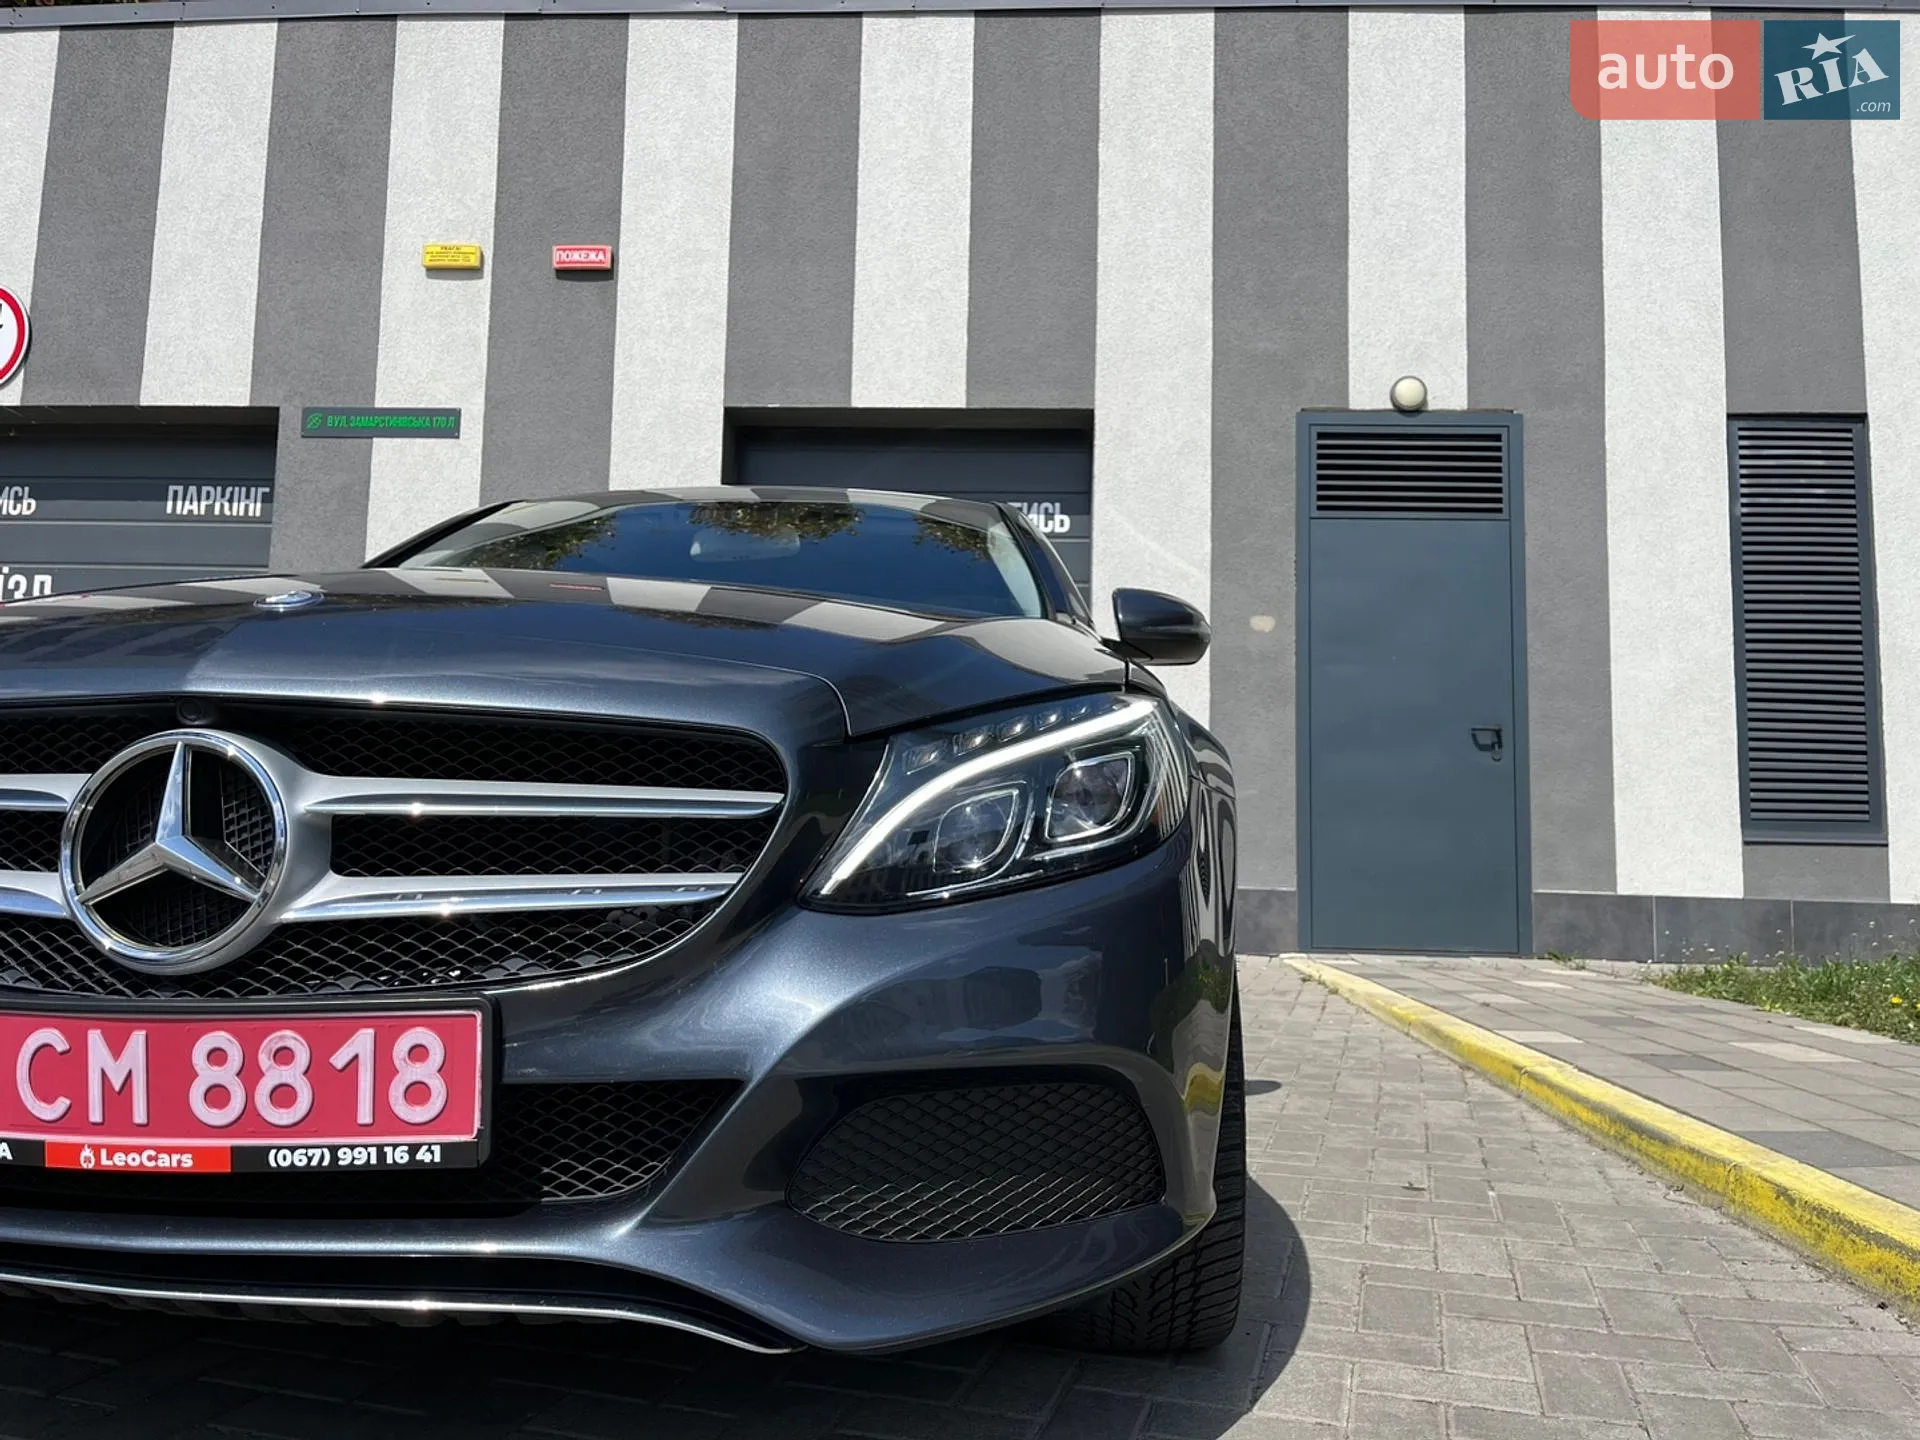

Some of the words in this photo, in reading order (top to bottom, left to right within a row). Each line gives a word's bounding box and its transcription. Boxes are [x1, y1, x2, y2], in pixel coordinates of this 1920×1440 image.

[556, 250, 605, 262] ПОЖЕЖА
[166, 485, 270, 517] ПАРКІНГ
[188, 1026, 449, 1128] 8818
[100, 1148, 193, 1168] LeoCars
[268, 1147, 330, 1168] (067)
[338, 1146, 377, 1166] 991
[385, 1145, 409, 1164] 16
[416, 1144, 441, 1163] 41
